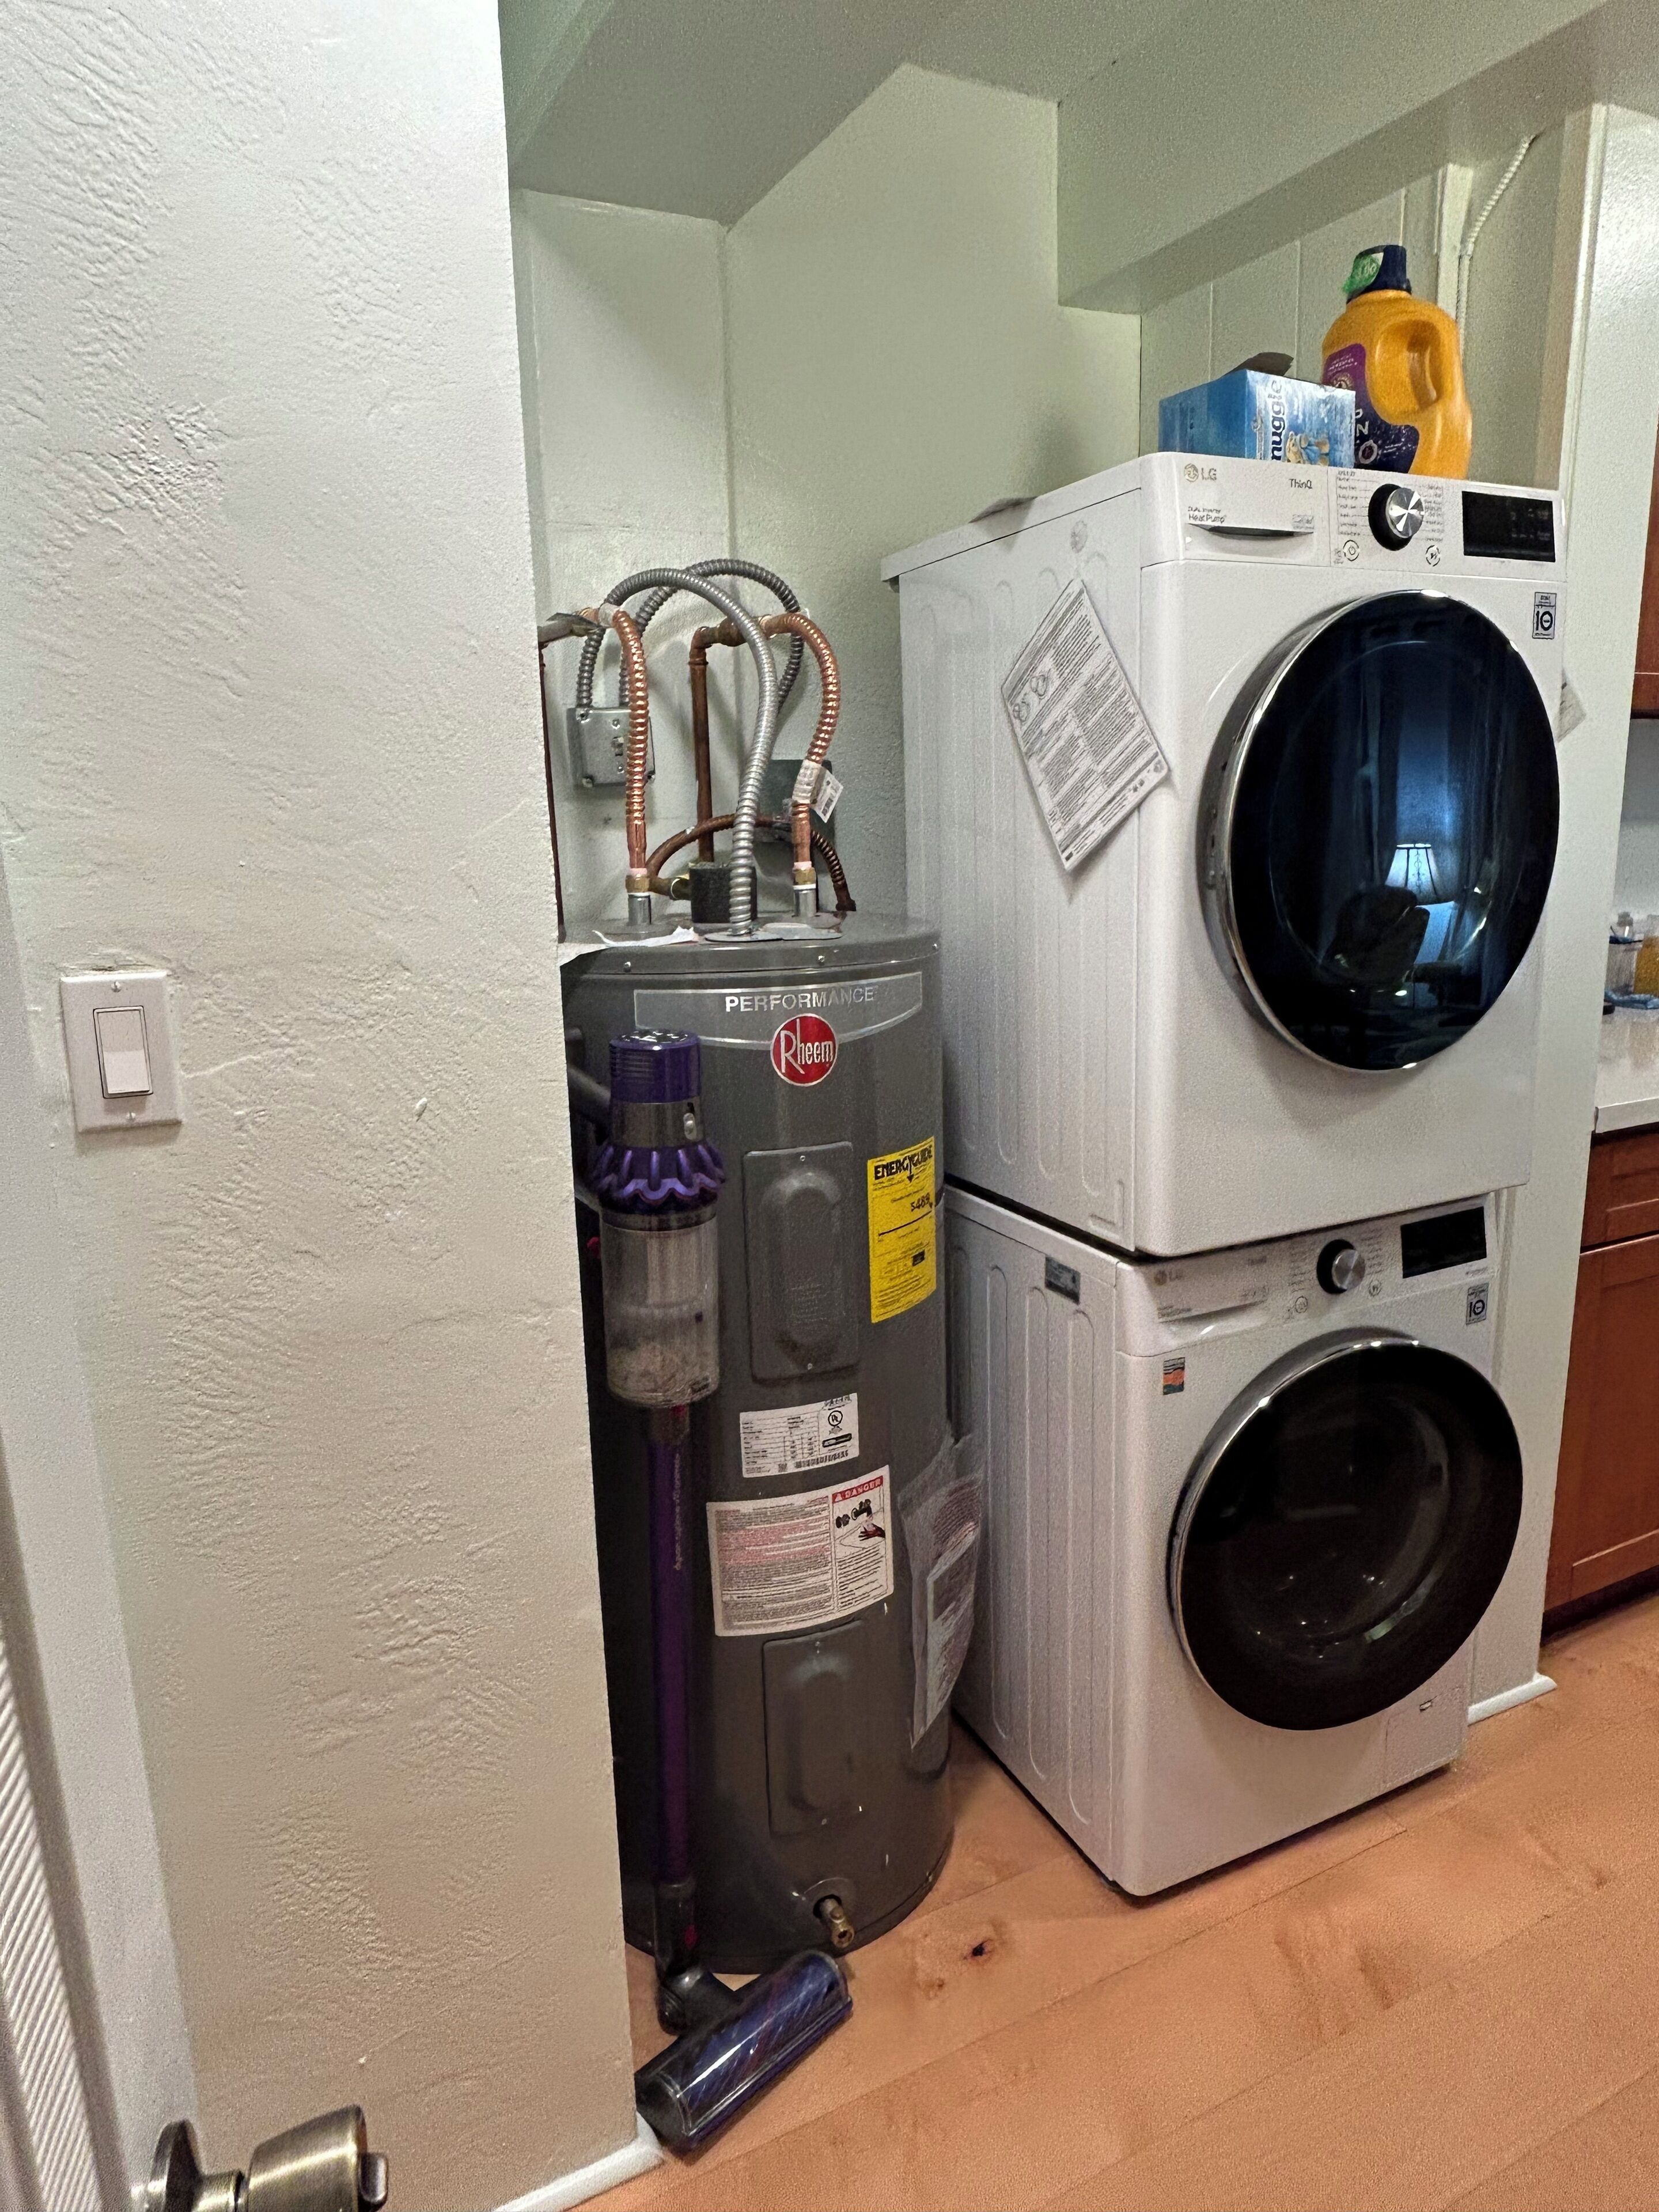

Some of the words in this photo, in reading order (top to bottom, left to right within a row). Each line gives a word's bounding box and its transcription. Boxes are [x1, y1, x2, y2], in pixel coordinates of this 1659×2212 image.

[1268, 380, 1285, 461] nuggle
[1201, 467, 1217, 481] LG
[725, 986, 875, 1012] PERFORMANCE
[780, 1018, 834, 1074] Rheem
